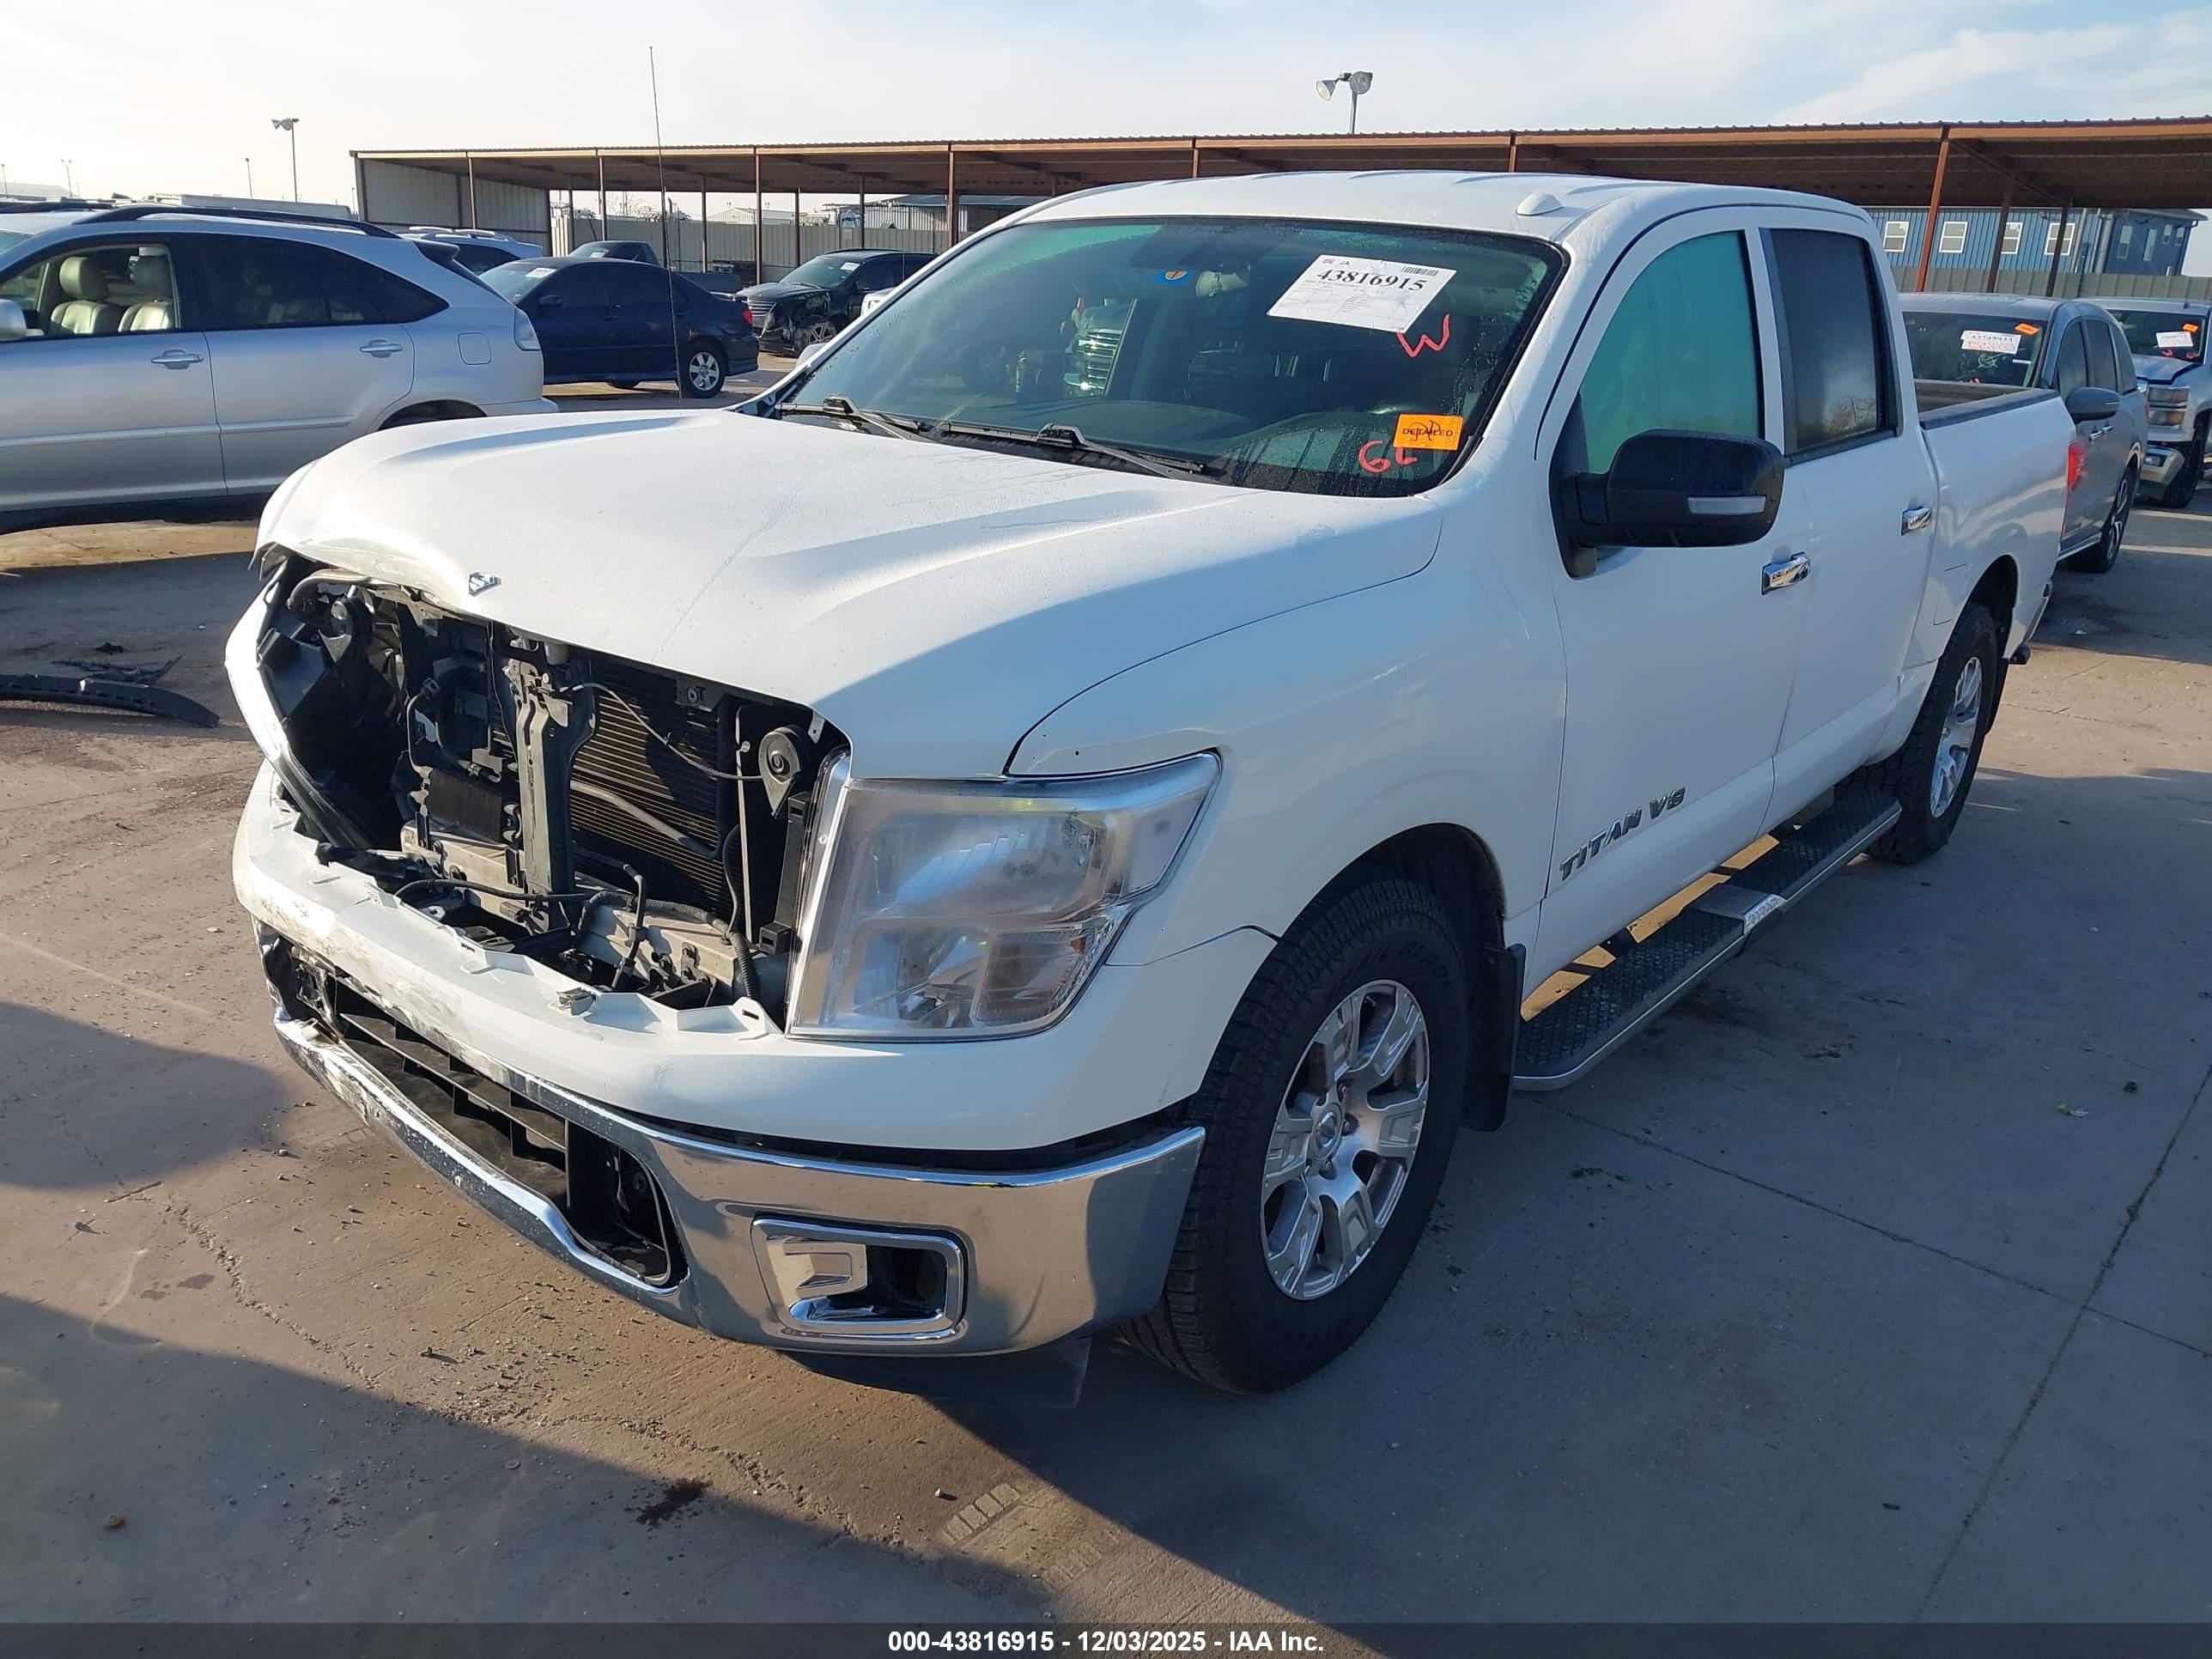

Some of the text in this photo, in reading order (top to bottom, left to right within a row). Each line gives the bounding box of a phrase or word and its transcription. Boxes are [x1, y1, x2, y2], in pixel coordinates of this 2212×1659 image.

[1316, 268, 1429, 292] 43816915
[1395, 313, 1451, 358] W
[1401, 427, 1454, 437] DETAILED
[1559, 787, 1686, 882] TITAN V8
